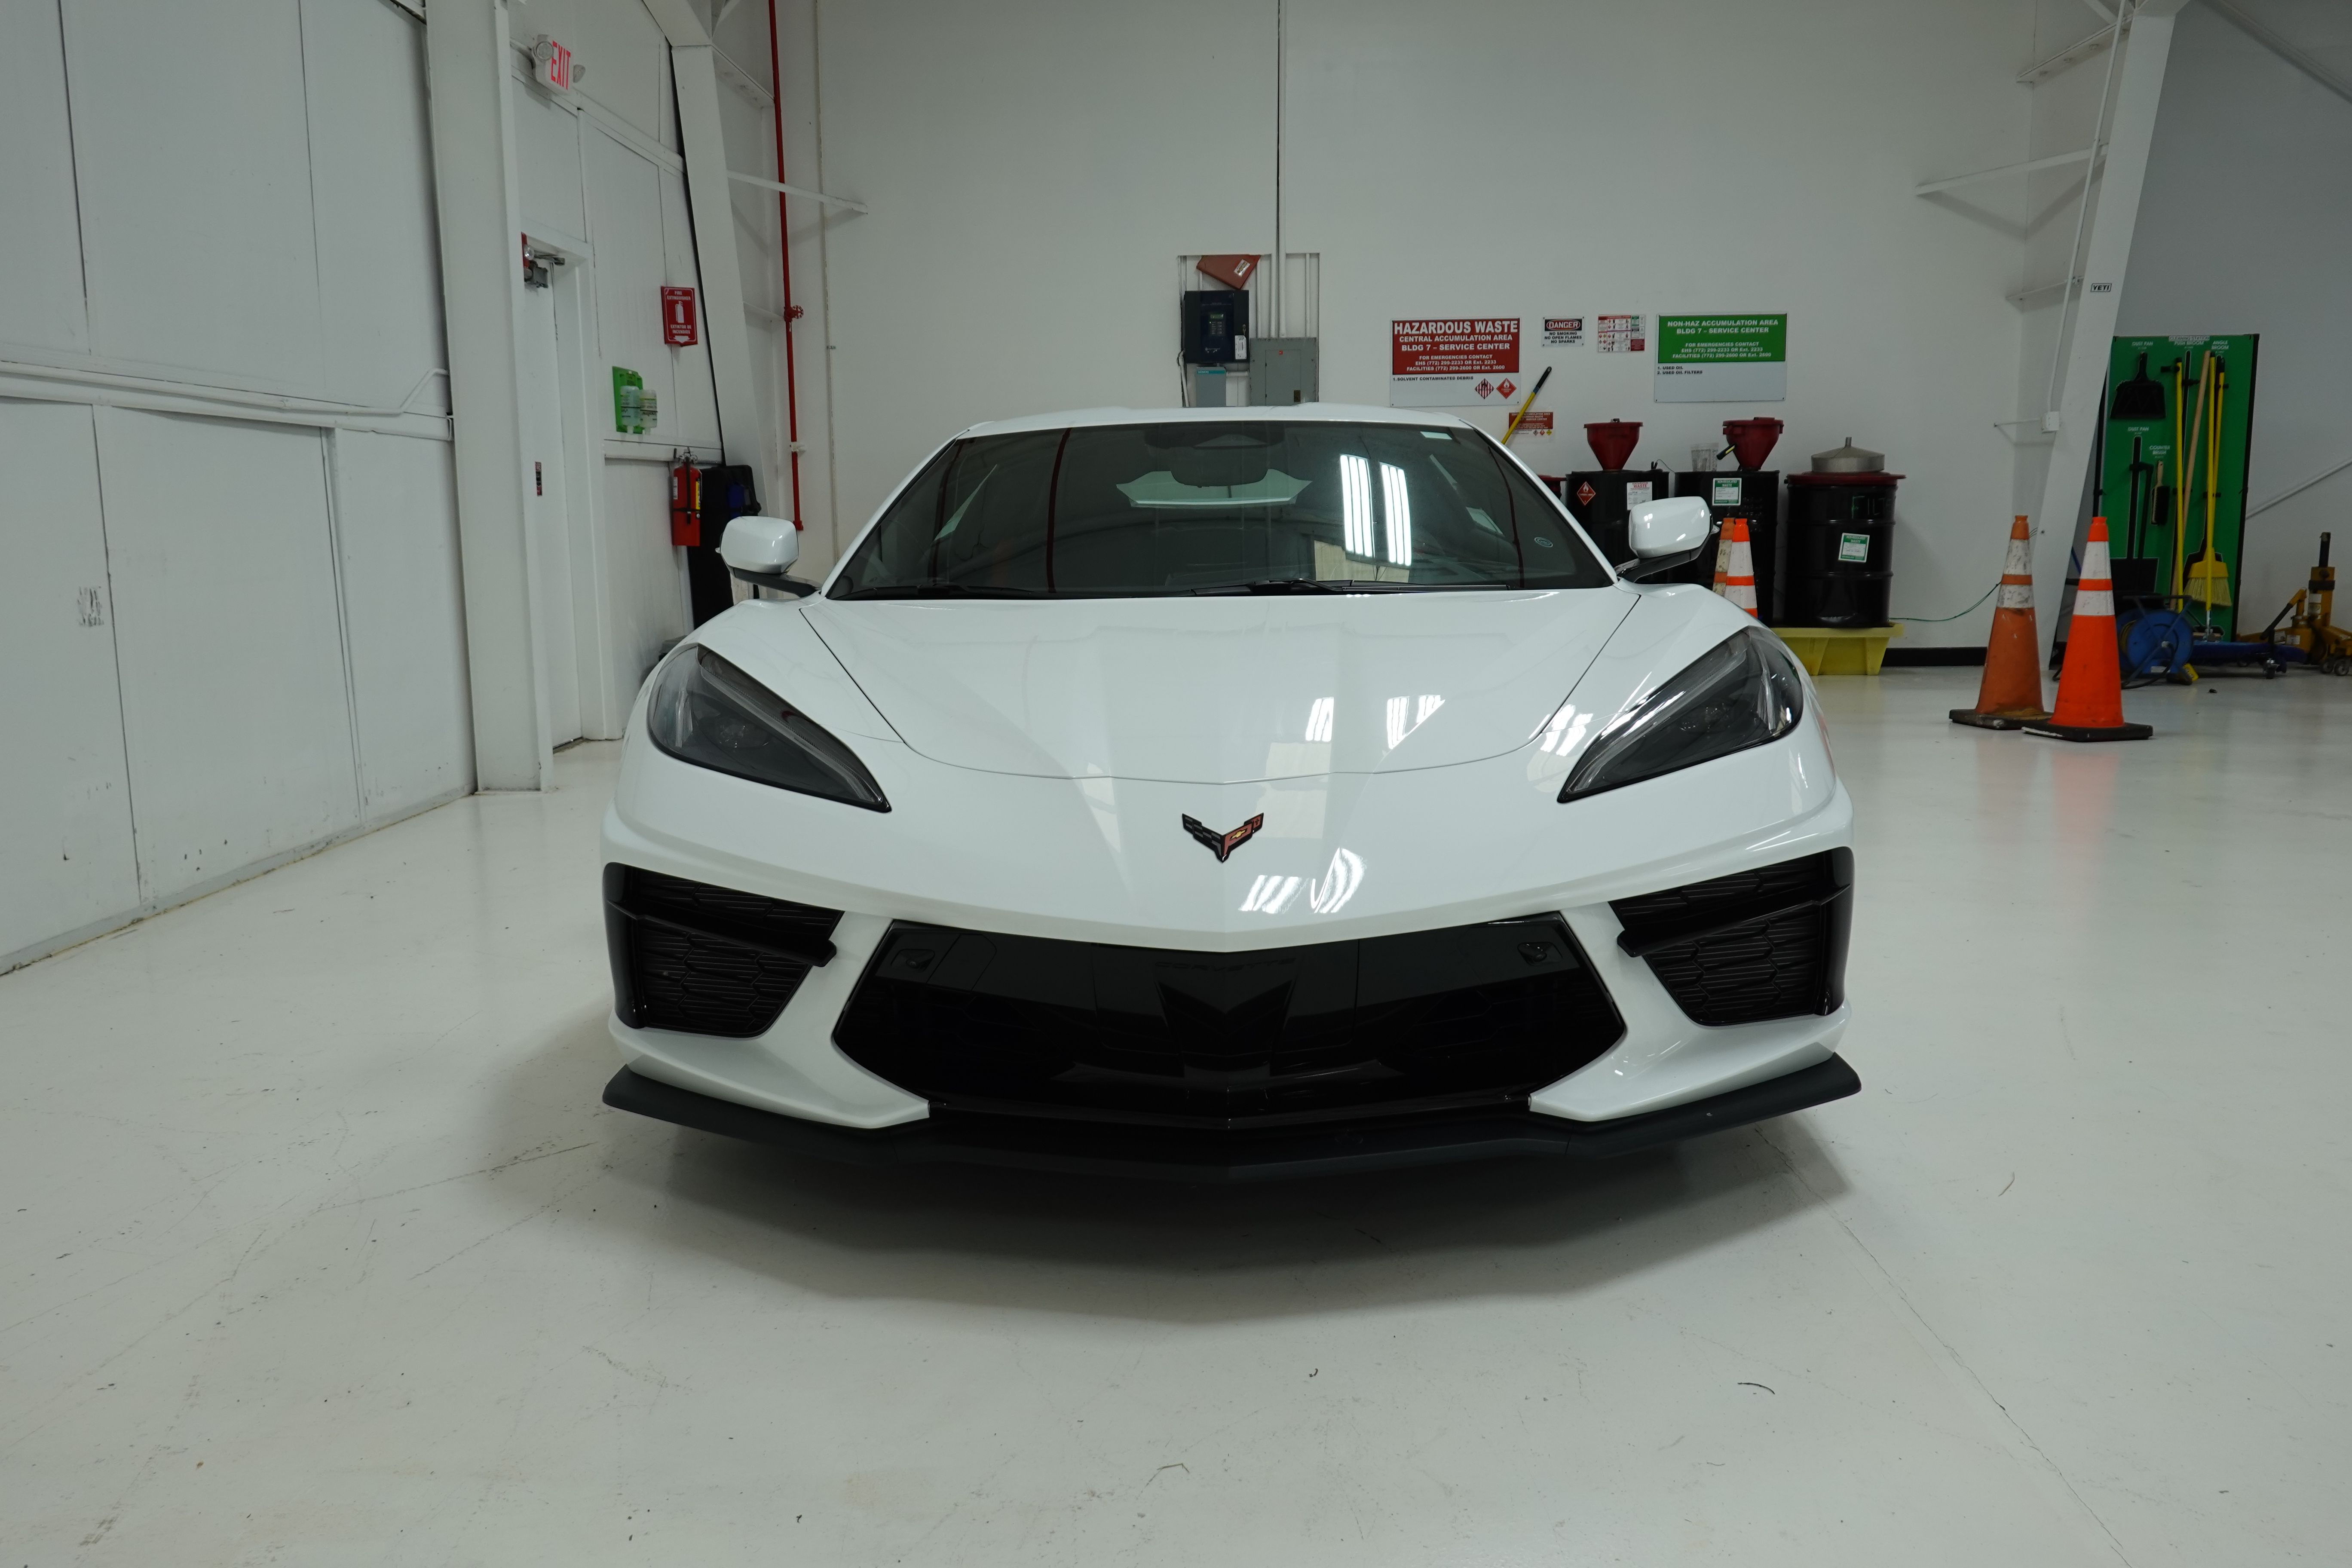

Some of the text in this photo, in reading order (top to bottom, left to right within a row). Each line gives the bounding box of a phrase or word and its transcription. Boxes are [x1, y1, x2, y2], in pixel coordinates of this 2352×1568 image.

[551, 40, 571, 90] EXIT
[1394, 320, 1518, 334] HAZARDOUS WASTE
